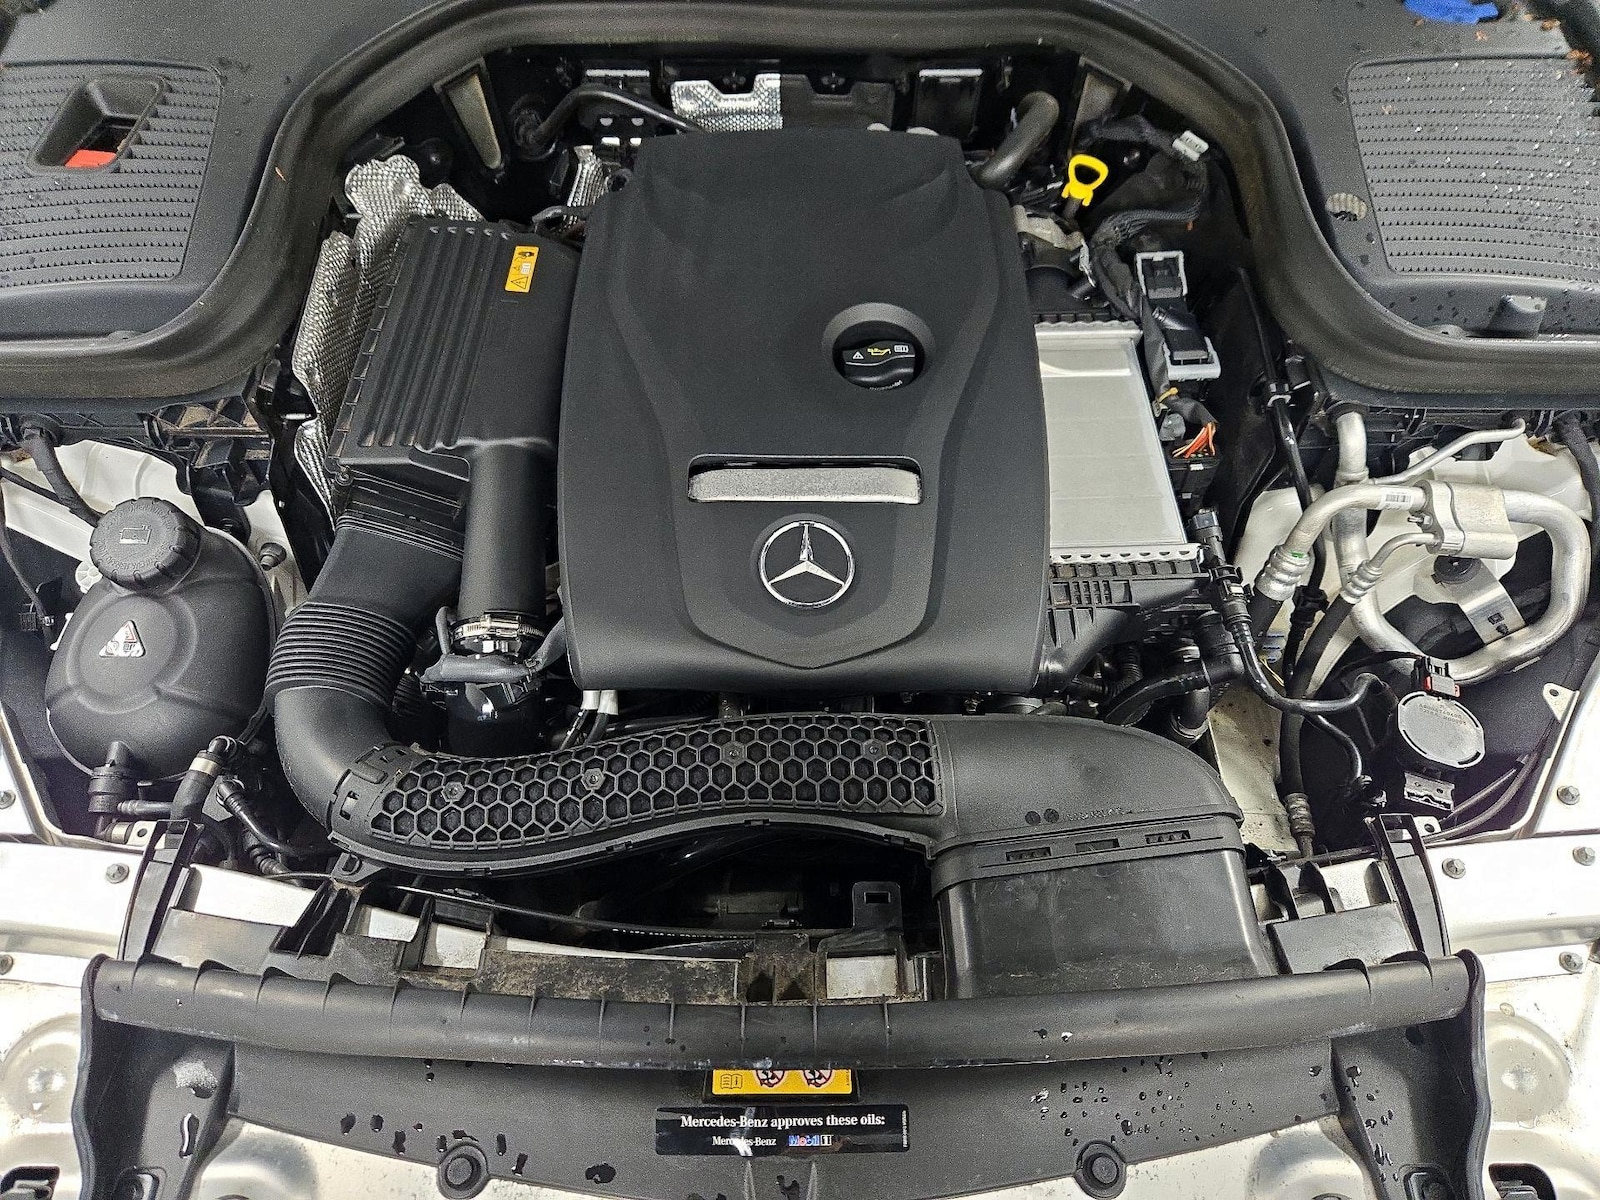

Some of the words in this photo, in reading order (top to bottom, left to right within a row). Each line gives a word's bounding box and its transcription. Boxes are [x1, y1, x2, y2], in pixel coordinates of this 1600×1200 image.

[680, 1115, 768, 1129] Mercedes-Benz
[770, 1116, 824, 1131] approves
[826, 1114, 858, 1127] these
[860, 1114, 886, 1126] oils:
[711, 1135, 777, 1147] Merces-Benz
[788, 1134, 820, 1147] Mobil
